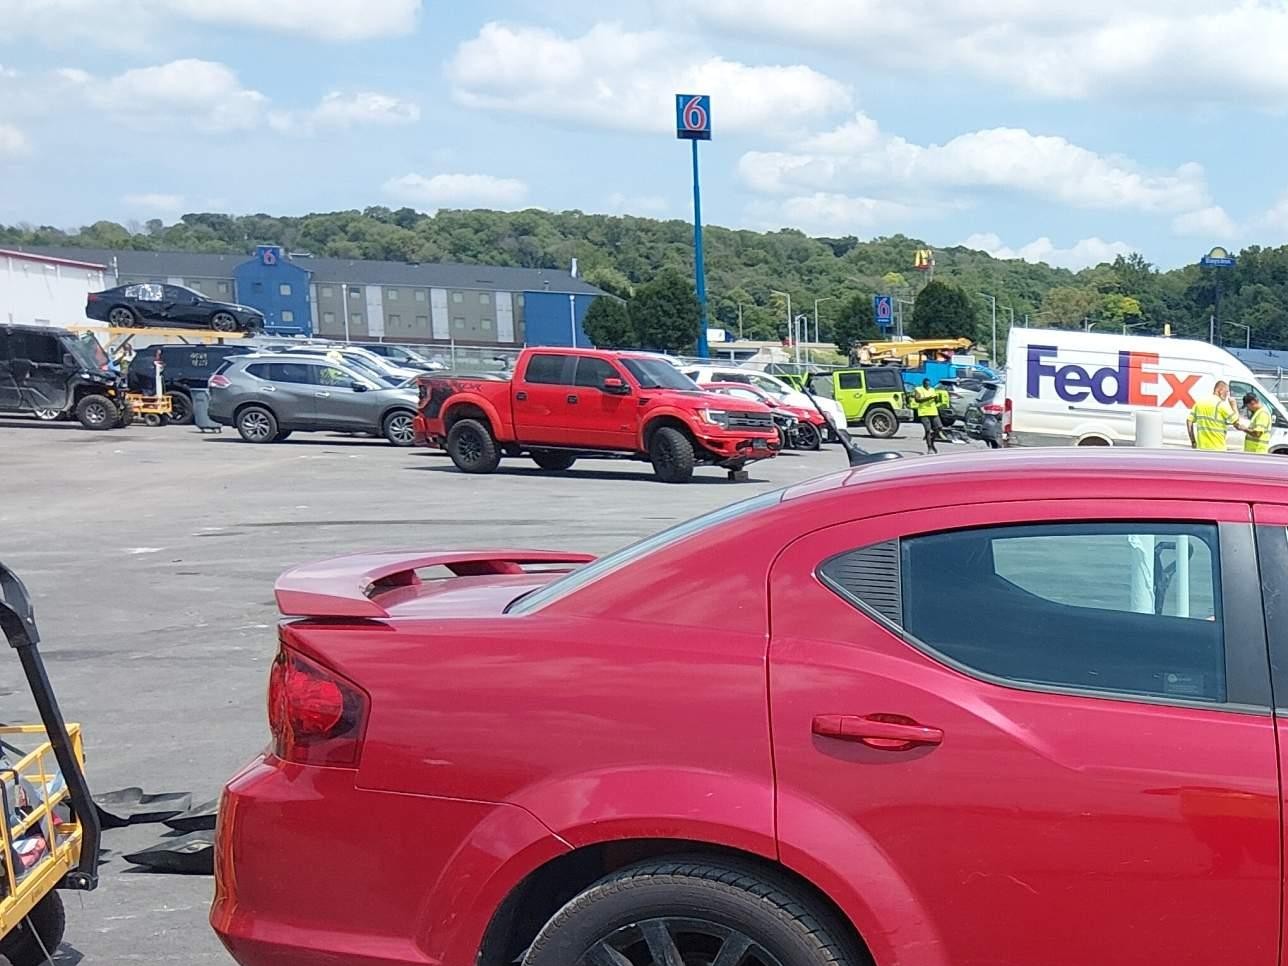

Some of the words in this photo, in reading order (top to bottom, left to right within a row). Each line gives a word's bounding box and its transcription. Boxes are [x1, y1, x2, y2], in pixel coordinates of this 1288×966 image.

[683, 96, 707, 130] 6
[878, 297, 890, 318] 6
[1026, 344, 1203, 409] FedEx
